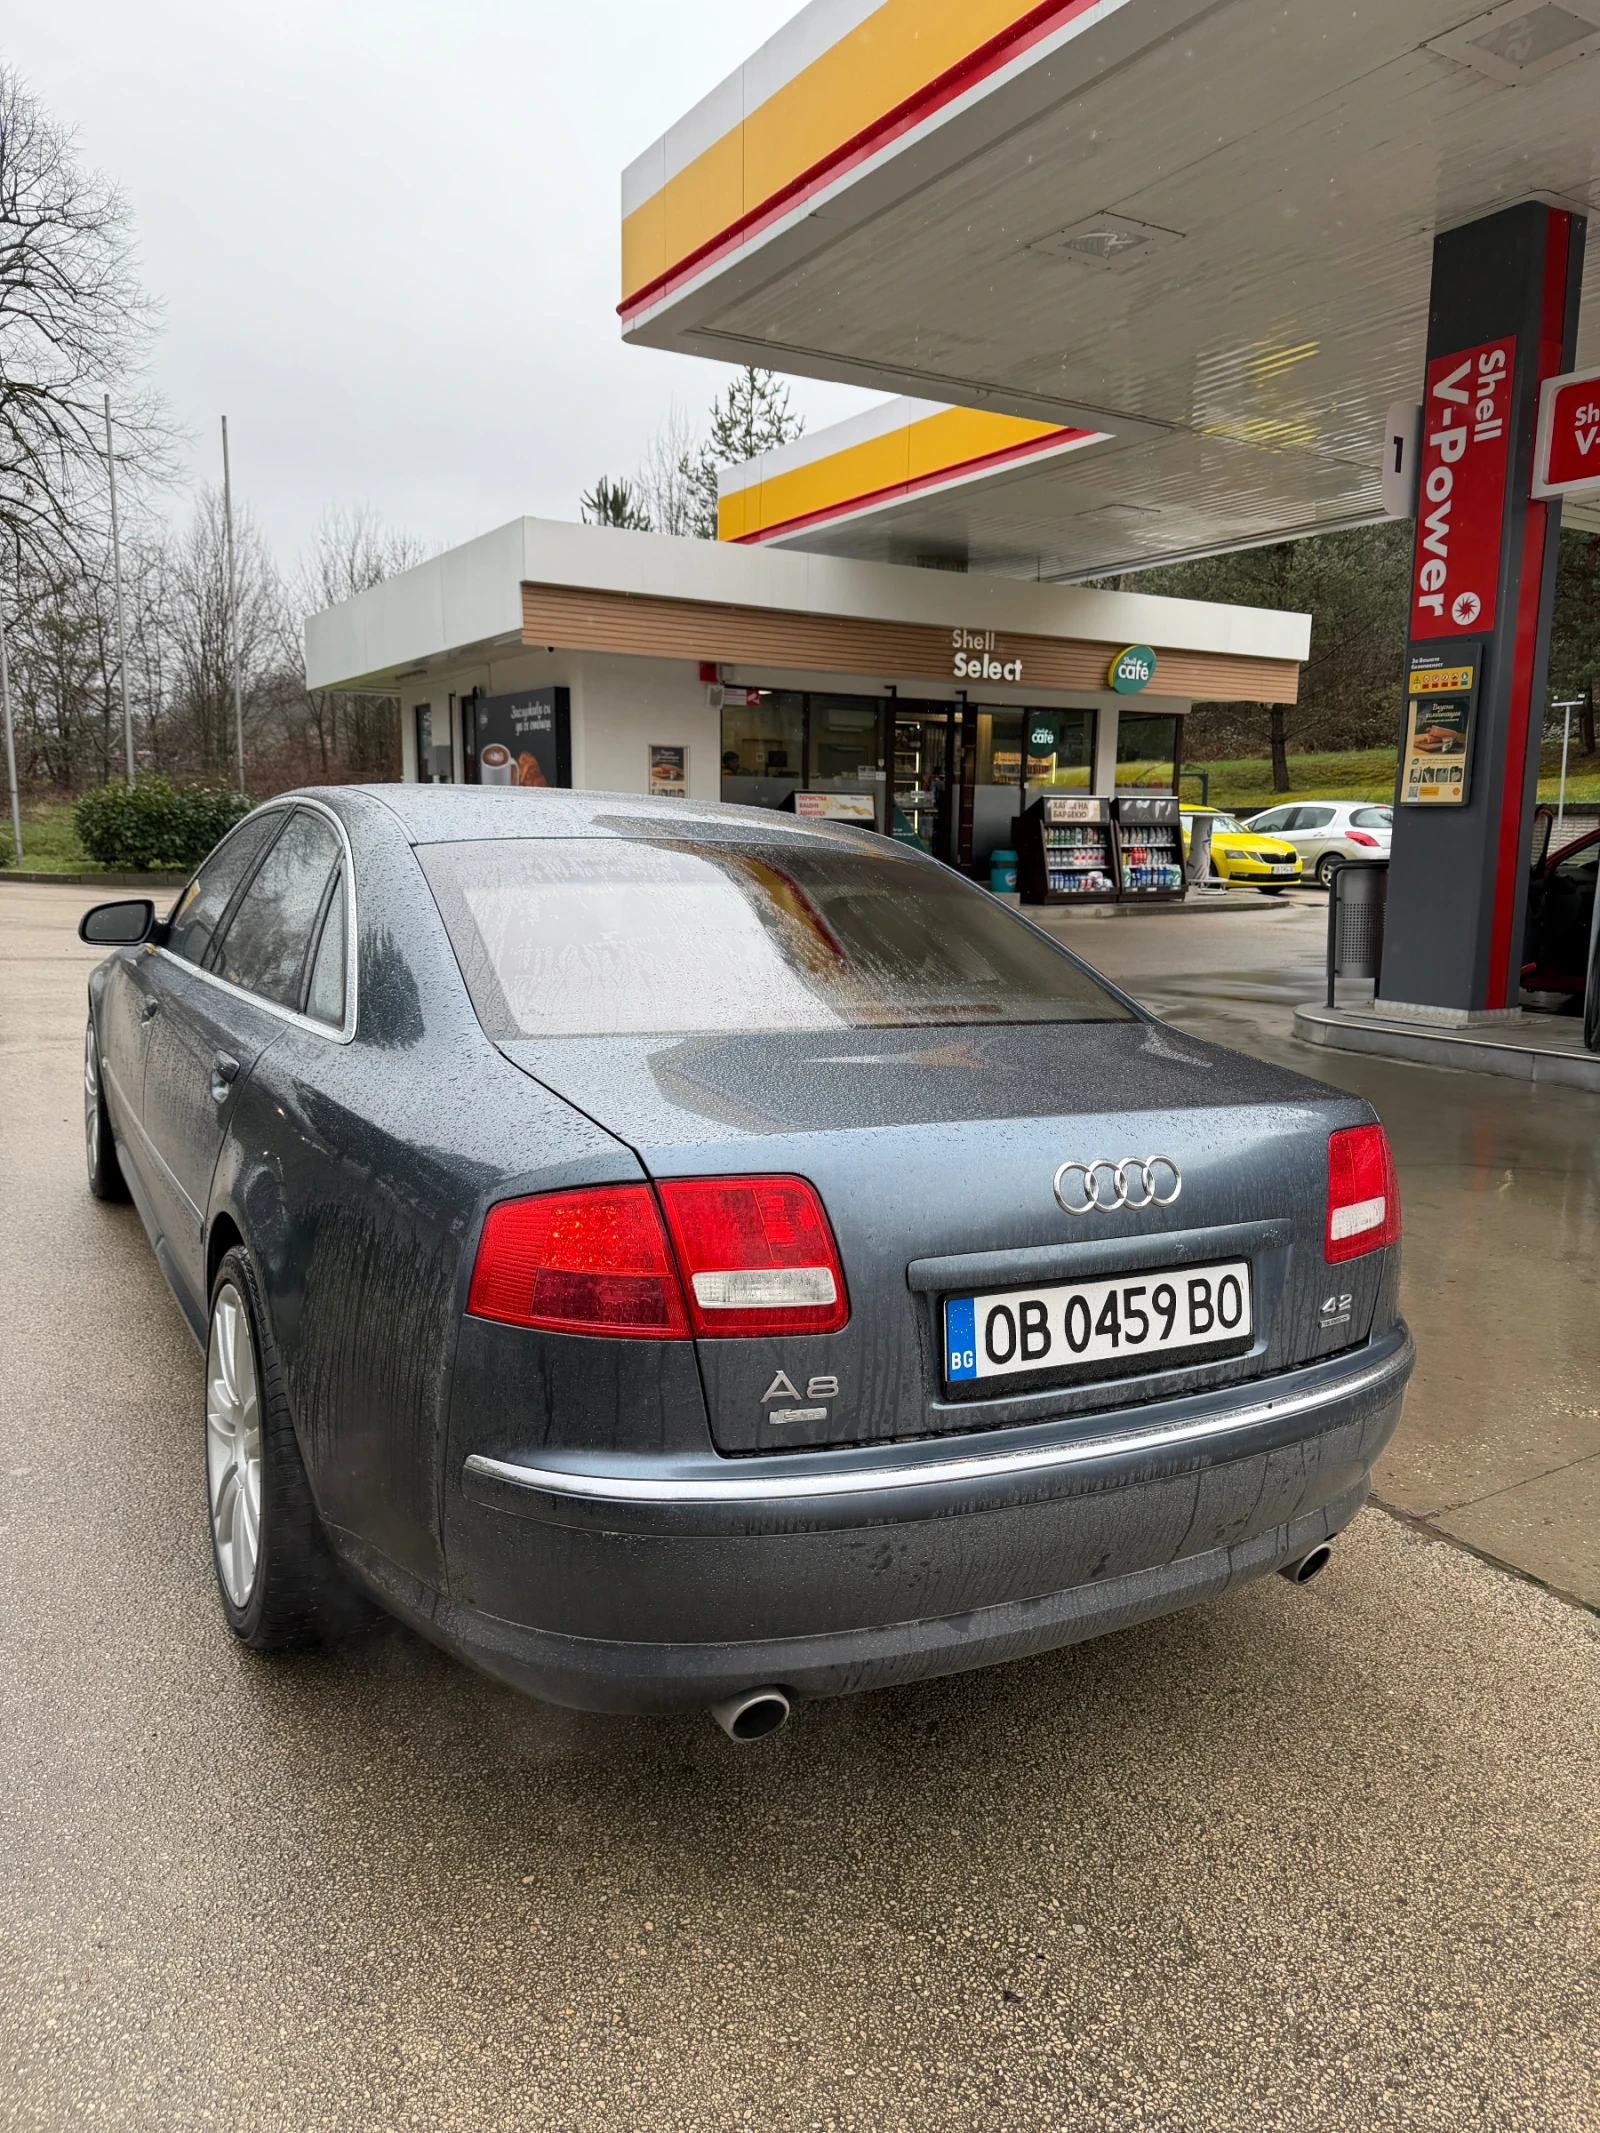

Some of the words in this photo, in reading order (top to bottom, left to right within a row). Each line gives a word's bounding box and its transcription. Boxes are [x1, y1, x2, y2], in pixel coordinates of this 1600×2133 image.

[1473, 349, 1507, 443] Shell
[1393, 435, 1404, 474] 1
[1418, 358, 1472, 617] V-Power
[952, 629, 995, 651] Shell
[953, 652, 1023, 681] Select
[1118, 660, 1149, 681] café
[1031, 729, 1054, 744] café
[985, 1300, 1051, 1365] OB
[1064, 1283, 1177, 1353] 0459
[1187, 1274, 1243, 1336] BO
[951, 1350, 974, 1370] BG
[760, 1370, 839, 1403] A8
